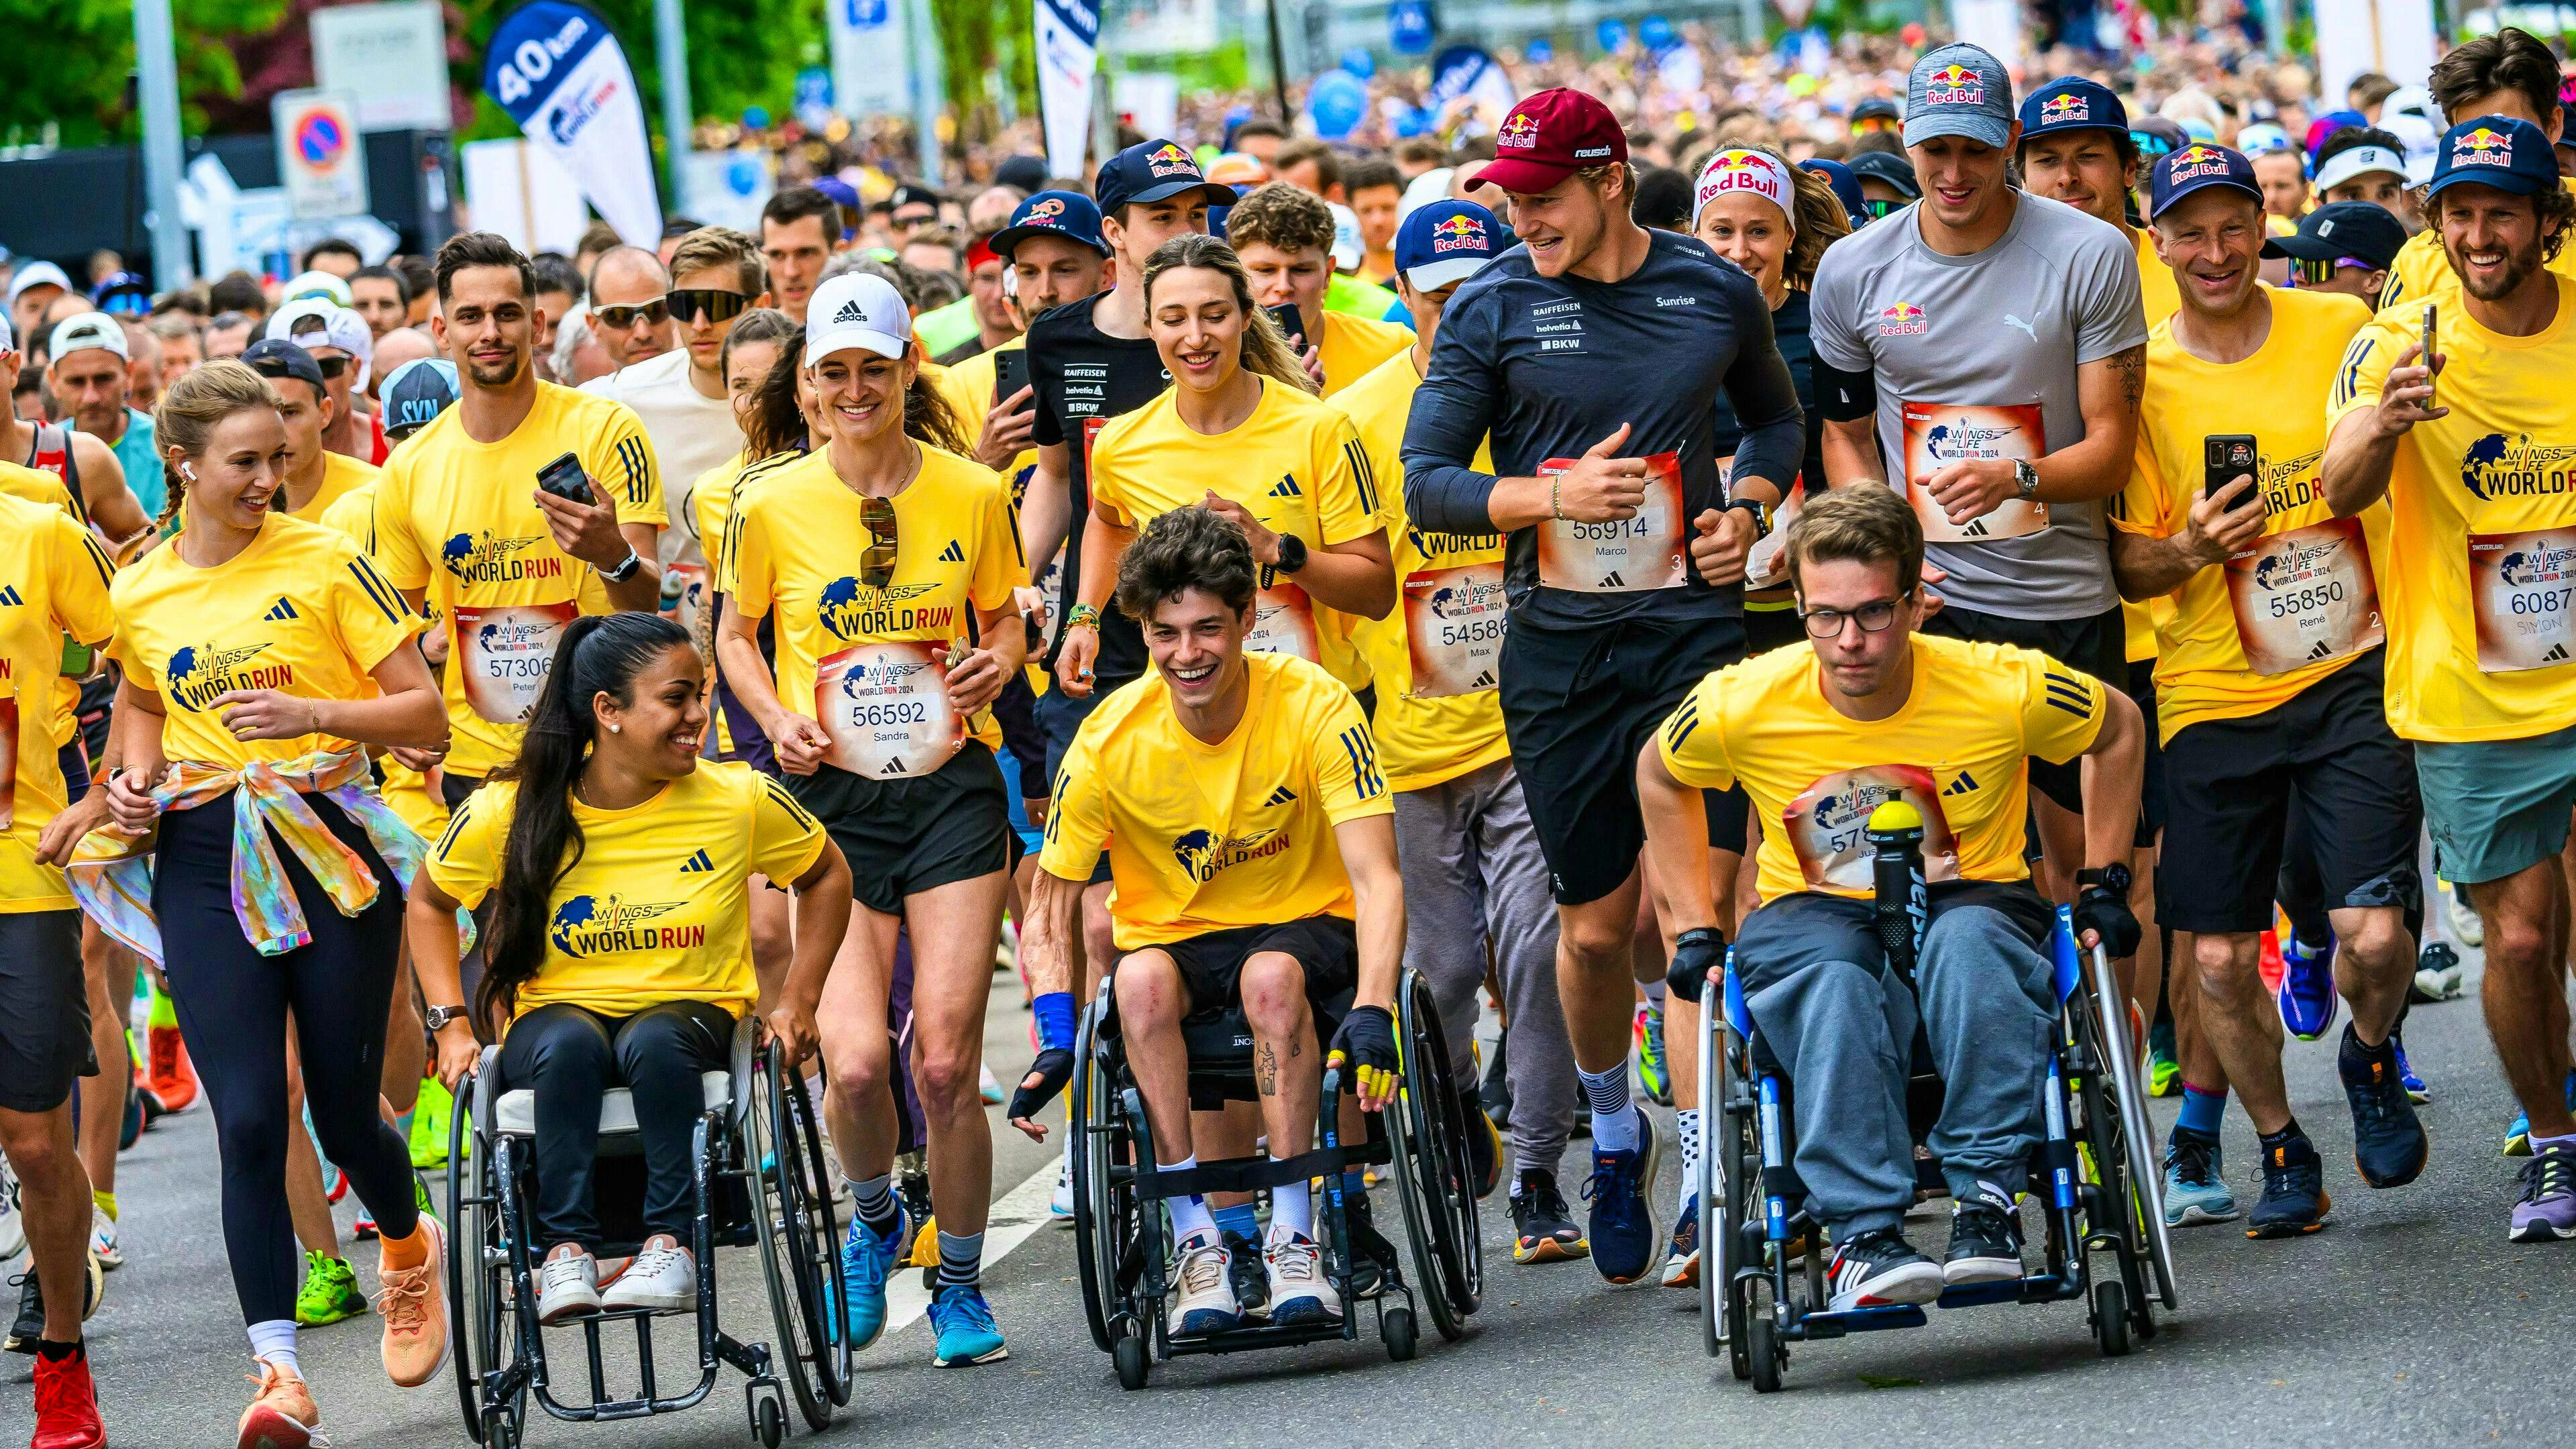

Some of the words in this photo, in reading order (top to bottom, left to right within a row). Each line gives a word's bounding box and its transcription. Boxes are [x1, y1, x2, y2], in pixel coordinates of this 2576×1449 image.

[1928, 88, 1955, 103] Red
[1957, 89, 1984, 104] Bull
[2043, 111, 2063, 124] Red
[2066, 110, 2088, 119] Bull
[1498, 131, 1514, 146] Red
[1515, 133, 1536, 148] Bull
[1575, 145, 1611, 158] reusch
[2453, 150, 2480, 167] Red
[2481, 151, 2510, 167] Bull
[1153, 162, 1180, 176] Red
[2172, 165, 2199, 184] Red
[2201, 163, 2229, 175] Bull
[1700, 172, 1733, 204] Red
[1738, 172, 1778, 199] Bull
[1436, 235, 1462, 252] Red
[1463, 235, 1488, 250] Bull
[1656, 296, 1695, 307] Sunrise
[1534, 303, 1580, 316] RAIFFEISEN
[833, 313, 867, 324] adidas
[1536, 323, 1570, 333] helvetia
[1880, 322, 1902, 335] Red
[1904, 321, 1926, 334] Bull
[1552, 339, 1580, 350] BKW
[1076, 403, 1099, 413] BKW
[1951, 430, 1993, 439] WINGS
[1957, 440, 1981, 448] LIFE
[1942, 449, 1965, 458] WORLD
[1981, 449, 1999, 458] 2024
[2507, 449, 2561, 460] WINGS
[2514, 460, 2546, 471] LIFE
[2486, 471, 2565, 495] WORLD
[2034, 502, 2045, 515] 4
[1572, 517, 1648, 540] 56914
[474, 540, 517, 555] WINGS
[1429, 534, 1497, 555] WORLD
[1596, 547, 1627, 555] Marco
[482, 551, 506, 562] LIFE
[1671, 554, 1682, 570] 3
[2279, 547, 2322, 565] WINGS
[2527, 550, 2573, 564] WINGS
[462, 560, 523, 584] WORLD
[525, 557, 561, 579] RUN
[2288, 559, 2312, 574] LIFE
[2534, 561, 2561, 573] LIFE
[2273, 574, 2298, 587] WORLD
[2298, 570, 2313, 581] RUN
[2313, 566, 2331, 577] 2024
[2518, 574, 2544, 584] WORLD
[2544, 573, 2559, 582] RUN
[859, 587, 910, 601] WINGS
[1456, 584, 1497, 598] WINGS
[867, 599, 896, 611] LIFE
[1462, 595, 1485, 606] LIFE
[2271, 581, 2343, 618] 55850
[2512, 586, 2576, 614] 6087
[1447, 607, 1470, 616] WORLD
[1471, 605, 1485, 614] RUN
[1486, 602, 1502, 611] 2024
[841, 609, 914, 636] WORLD
[916, 606, 953, 629] RUN
[2300, 614, 2326, 629] René
[2369, 611, 2381, 628] 2
[2517, 616, 2563, 635] SIMON
[500, 625, 537, 635] WINGS
[1252, 629, 1270, 639] 2024
[506, 635, 527, 643] LIFE
[1470, 648, 1491, 657] Max
[197, 651, 241, 671] WINGS
[490, 657, 553, 678] 57306
[206, 665, 231, 680] LIFE
[252, 665, 292, 690] RUN
[868, 665, 910, 676] WINGS
[513, 683, 536, 691] Peter
[875, 676, 898, 686] LIFE
[859, 687, 883, 697] WORLD
[884, 686, 897, 694] RUN
[898, 686, 914, 694] 2024
[853, 702, 926, 727] 56592
[873, 732, 909, 741] Sandra
[952, 741, 962, 754] 3
[1839, 787, 1885, 804] WINGS
[1849, 796, 1873, 812] LIFE
[1833, 812, 1859, 826] WORLD
[1860, 805, 1874, 818] RUN
[1251, 833, 1290, 859] RUN
[1942, 850, 1955, 865] 2
[595, 906, 652, 920] WINGS
[604, 918, 637, 931] LIFE
[575, 928, 658, 955] WORLD
[661, 924, 705, 949] RUN
